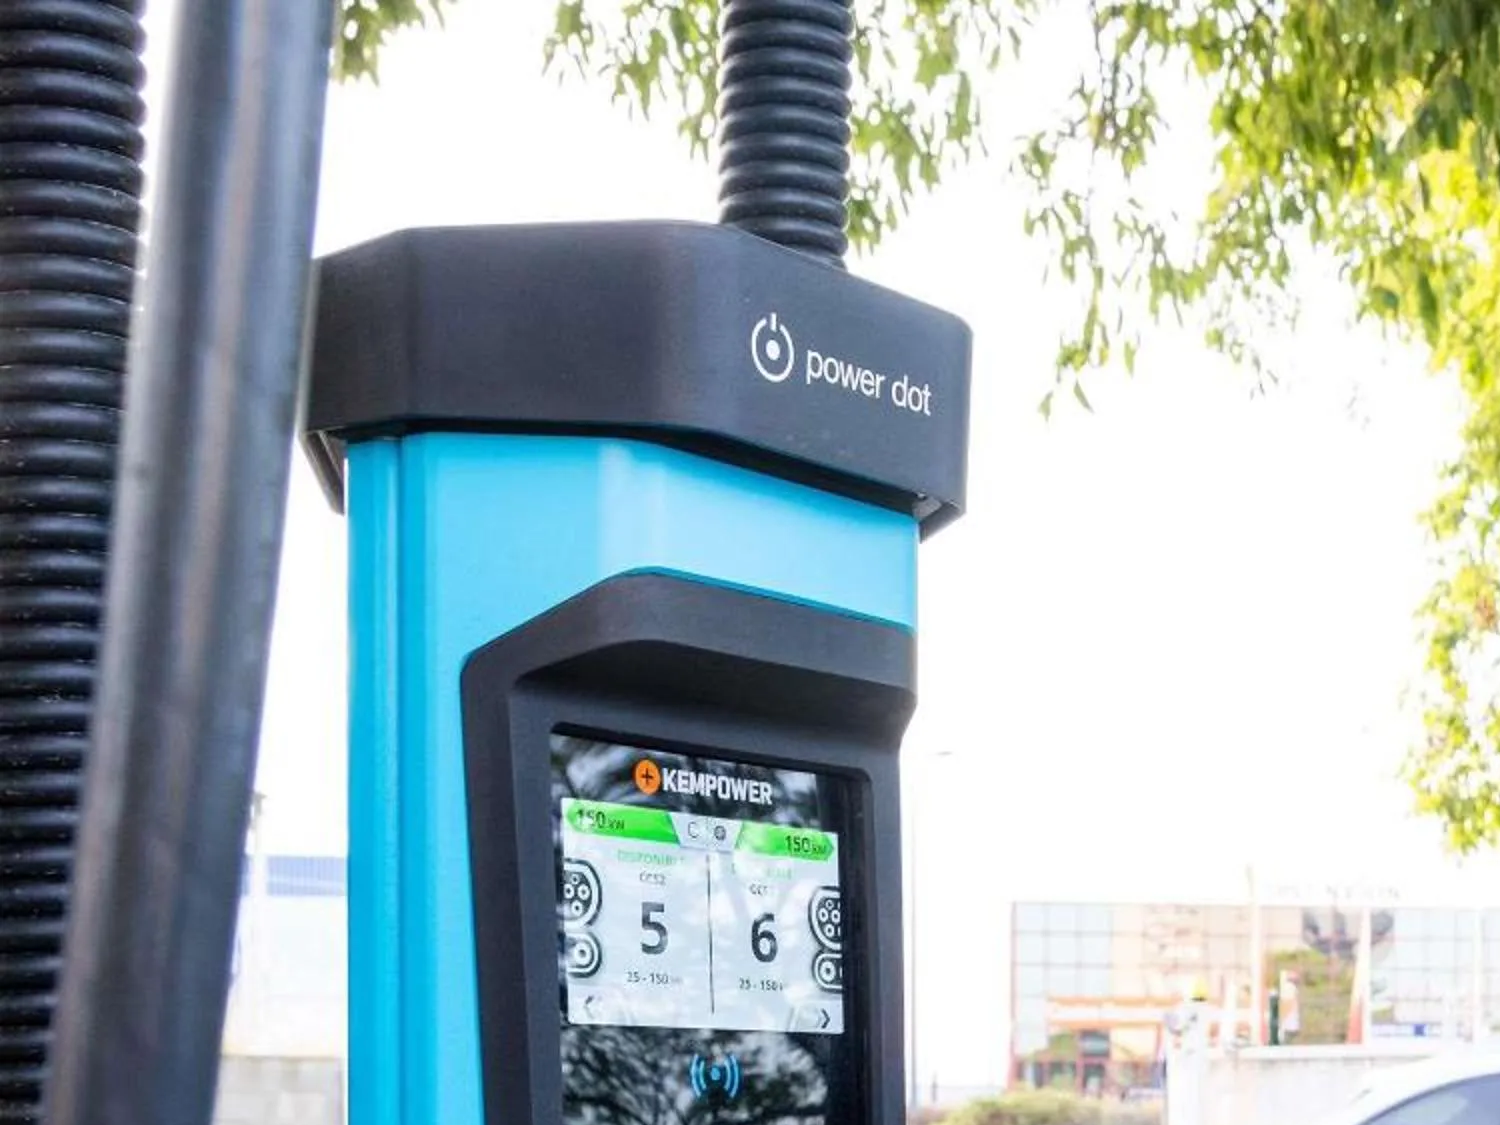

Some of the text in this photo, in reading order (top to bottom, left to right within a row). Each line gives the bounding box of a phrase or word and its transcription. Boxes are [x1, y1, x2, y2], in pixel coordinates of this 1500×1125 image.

[806, 350, 932, 416] power dot
[663, 767, 772, 805] KEMPOWER
[785, 835, 811, 853] 150
[641, 901, 668, 955] 5
[751, 912, 777, 963] 6
[626, 971, 640, 982] 25
[650, 972, 669, 985] 150
[739, 978, 752, 990] 25
